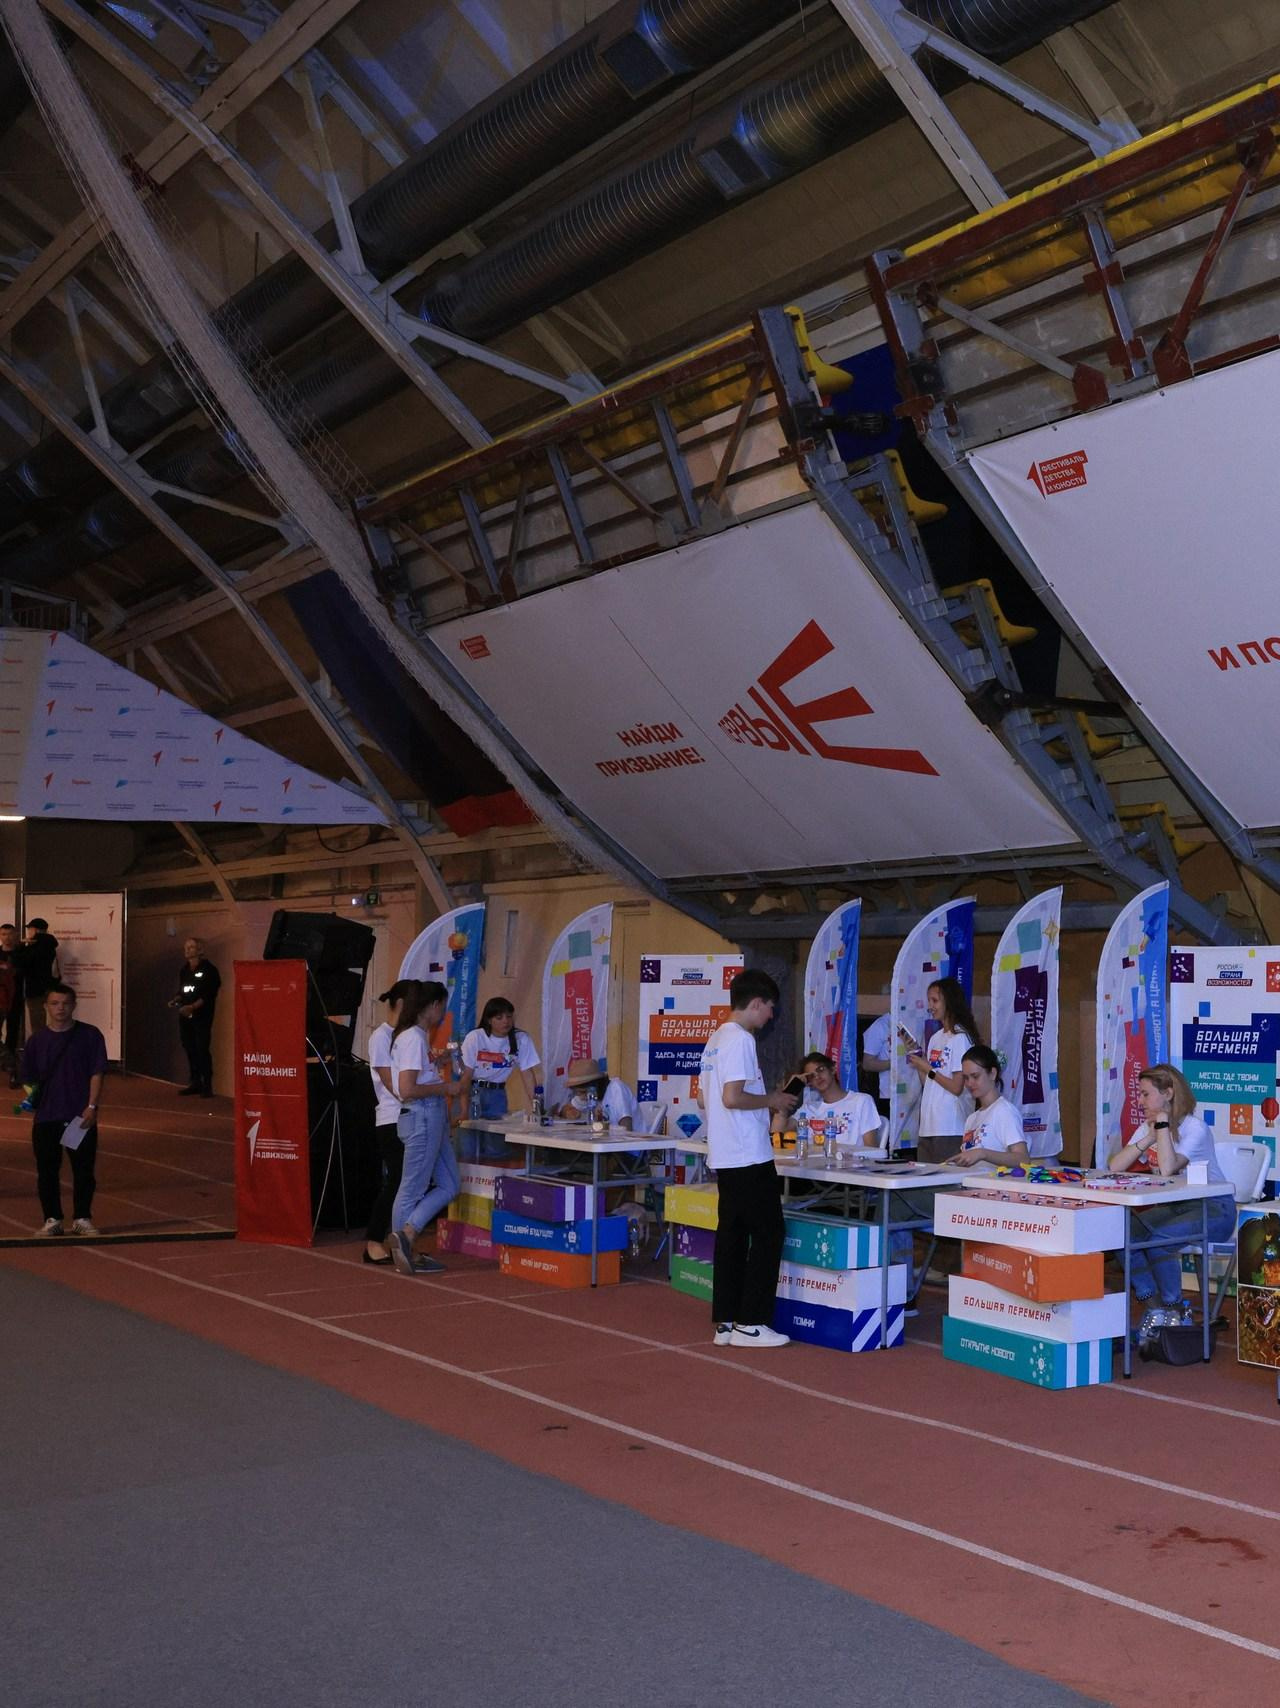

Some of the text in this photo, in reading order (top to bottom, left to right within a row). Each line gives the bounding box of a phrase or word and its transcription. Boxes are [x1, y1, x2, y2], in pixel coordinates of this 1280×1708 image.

[1041, 456, 1085, 471] ФЕСТИВАЛЬ
[1044, 468, 1076, 482] ДЕТСТВА
[1053, 476, 1086, 490] ЮНОСТИ
[1209, 646, 1242, 673] И
[616, 721, 684, 748] НАЙДИ
[596, 746, 705, 777] ПРИЗВАНИЕ!
[662, 1019, 718, 1028] БОЛЬШАЯ
[1196, 1031, 1260, 1043] БОЛЬШАЯ
[1195, 1043, 1258, 1055] ПЕРЕМЕНА
[951, 1214, 1051, 1234] БОЛЬШАЯ ПЕРЕМЕНА
[796, 1278, 837, 1292] ПЕРЕМЕНА
[964, 1296, 1052, 1322] БОЛЬШАЯ ПЕРЕМЕНА
